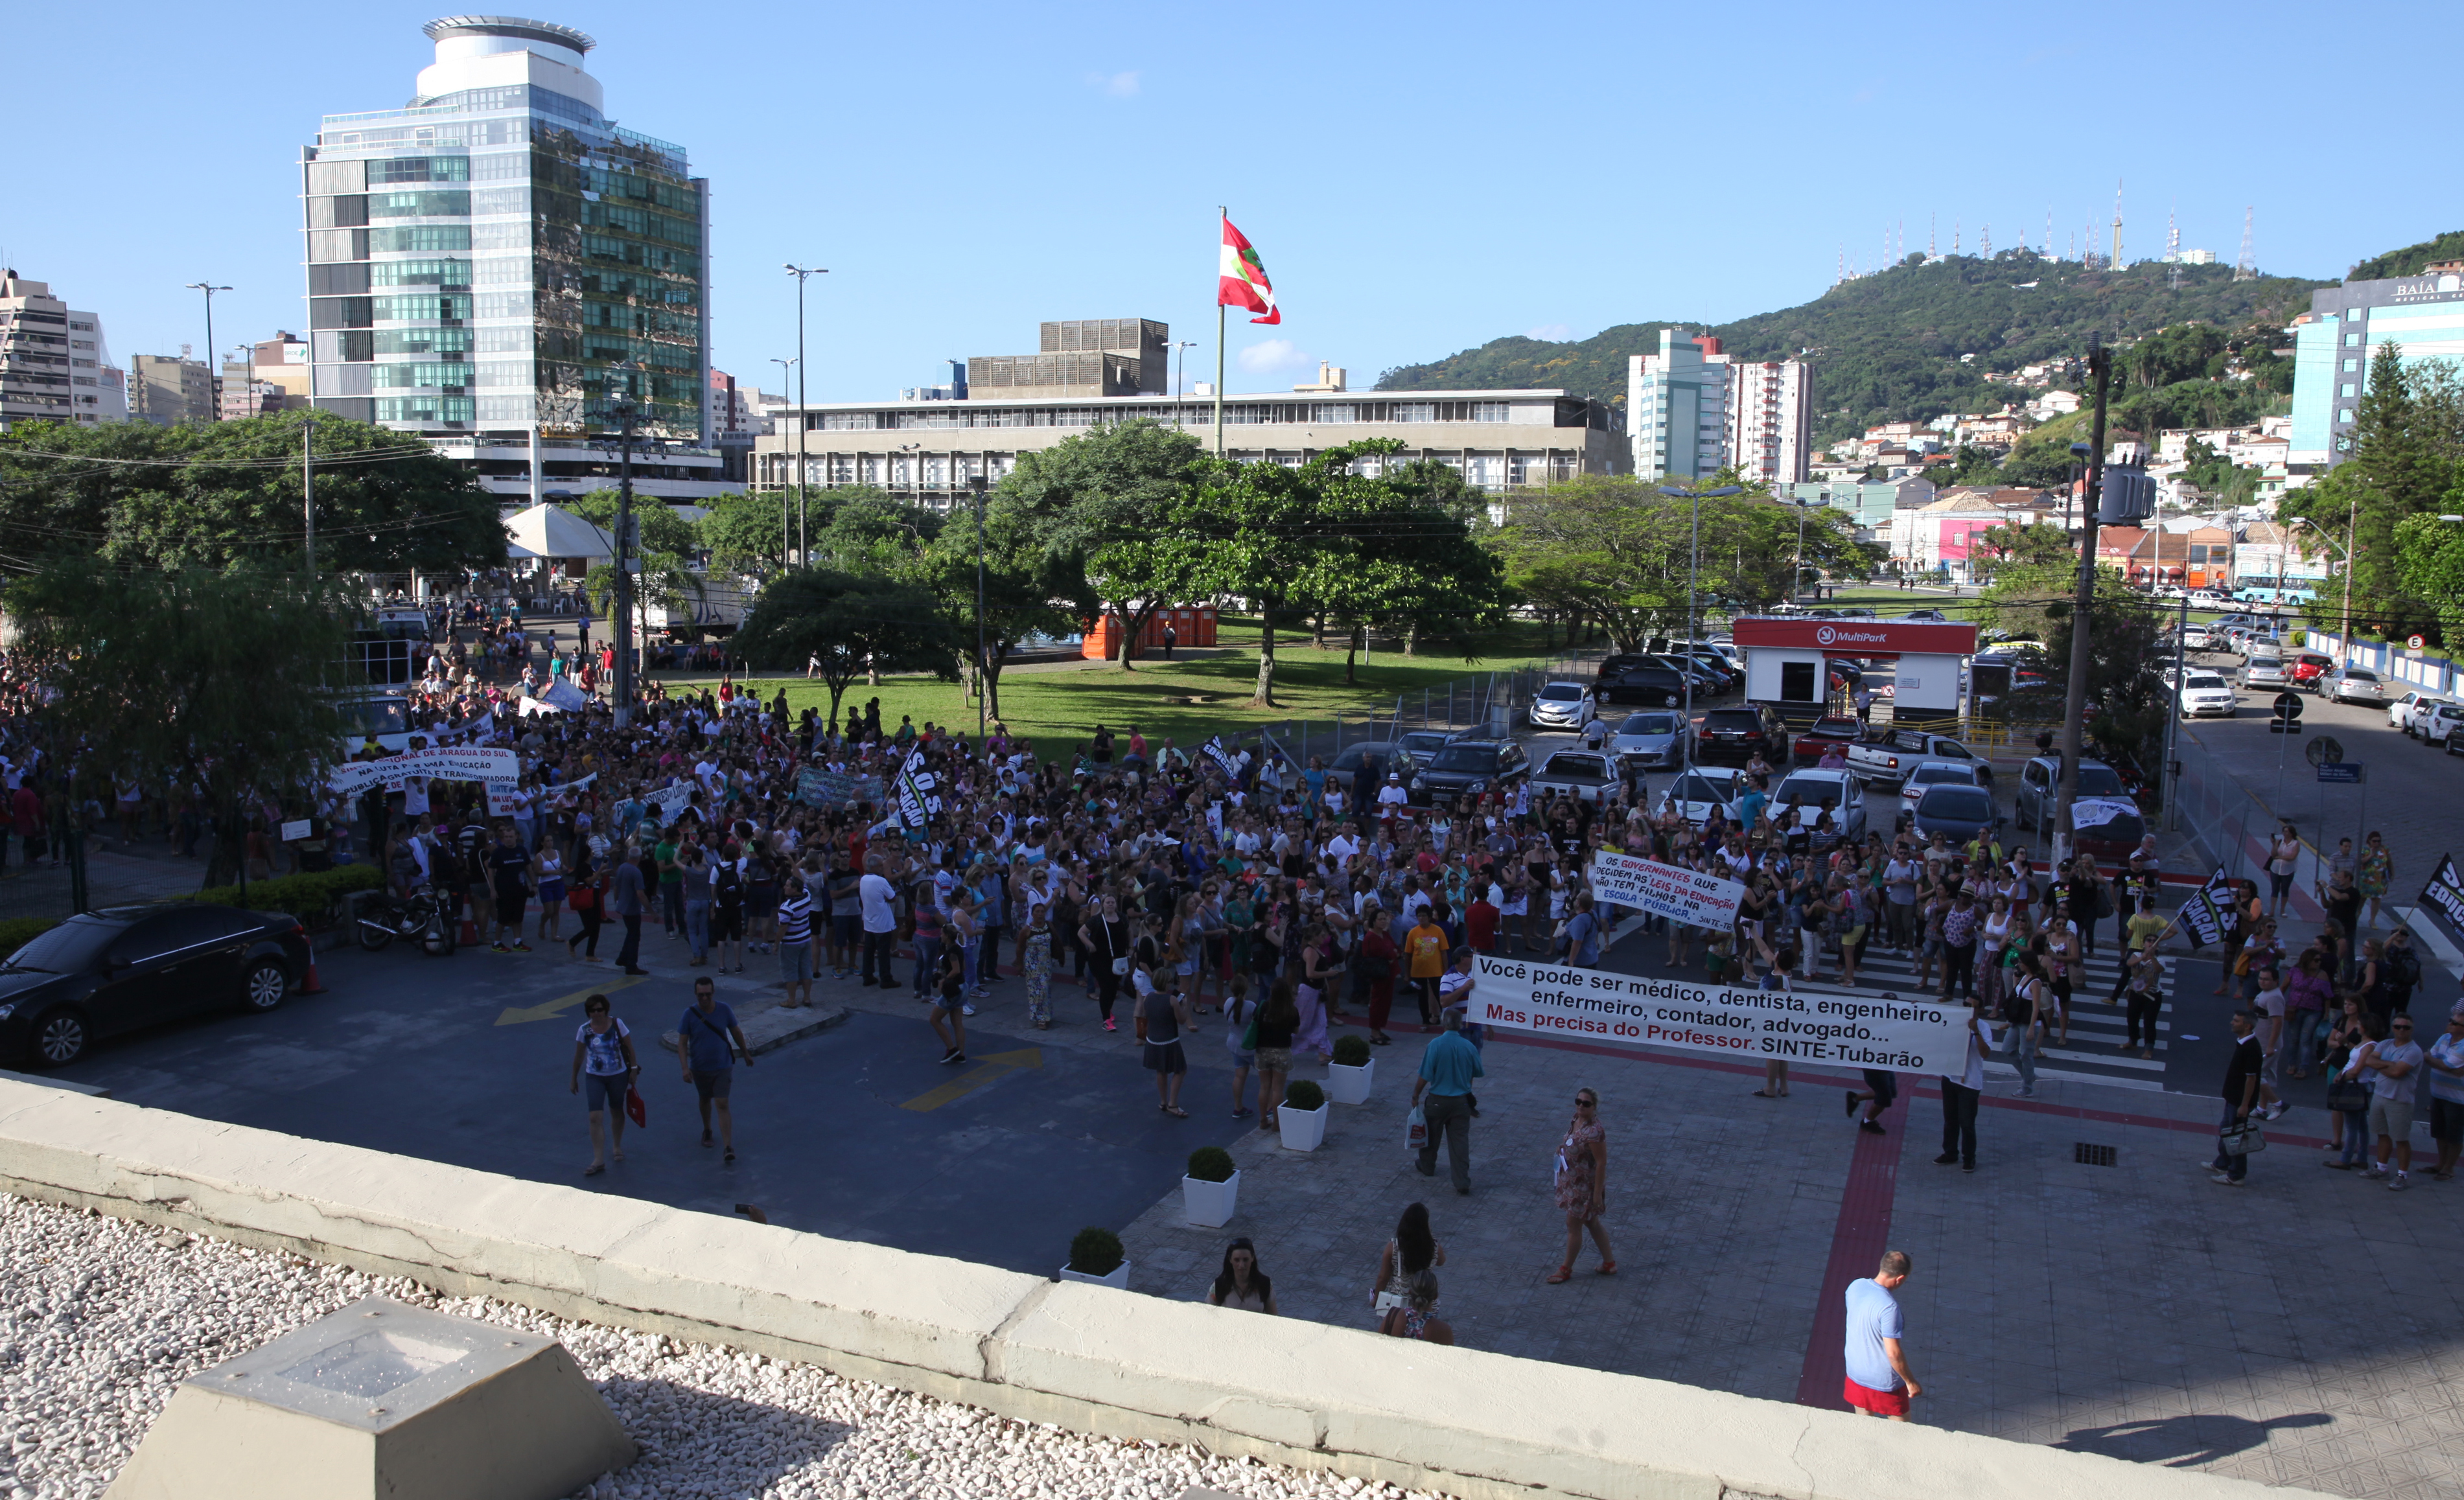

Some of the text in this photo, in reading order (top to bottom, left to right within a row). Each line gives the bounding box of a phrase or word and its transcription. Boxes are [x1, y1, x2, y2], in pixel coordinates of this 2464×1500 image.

[2397, 281, 2435, 295] BAÍA
[2412, 638, 2419, 647] E
[358, 768, 373, 777] NA
[387, 768, 433, 780] GRATUITA
[444, 770, 516, 783] TRANSFORMADORA
[803, 768, 822, 778] Governo
[490, 784, 509, 793] SINTE
[807, 785, 817, 794] hoje
[1606, 857, 1719, 892] OS GOVERNANTES QUE
[1595, 876, 1700, 911] NÃO TEM FILHOS NA
[1596, 866, 1736, 910] DECIDEM AS LEIS DA EDUCAÇÃO
[1603, 889, 1691, 920] ESCOLA PÚBLICA.
[1479, 958, 1948, 1027] Você pode ser médico, dentista, engenheiro,
[1531, 989, 1890, 1042] enfermeiro, contador, advogado...
[1486, 1003, 1924, 1068] Mas precisa do Professor. SINTE-Tubarão
